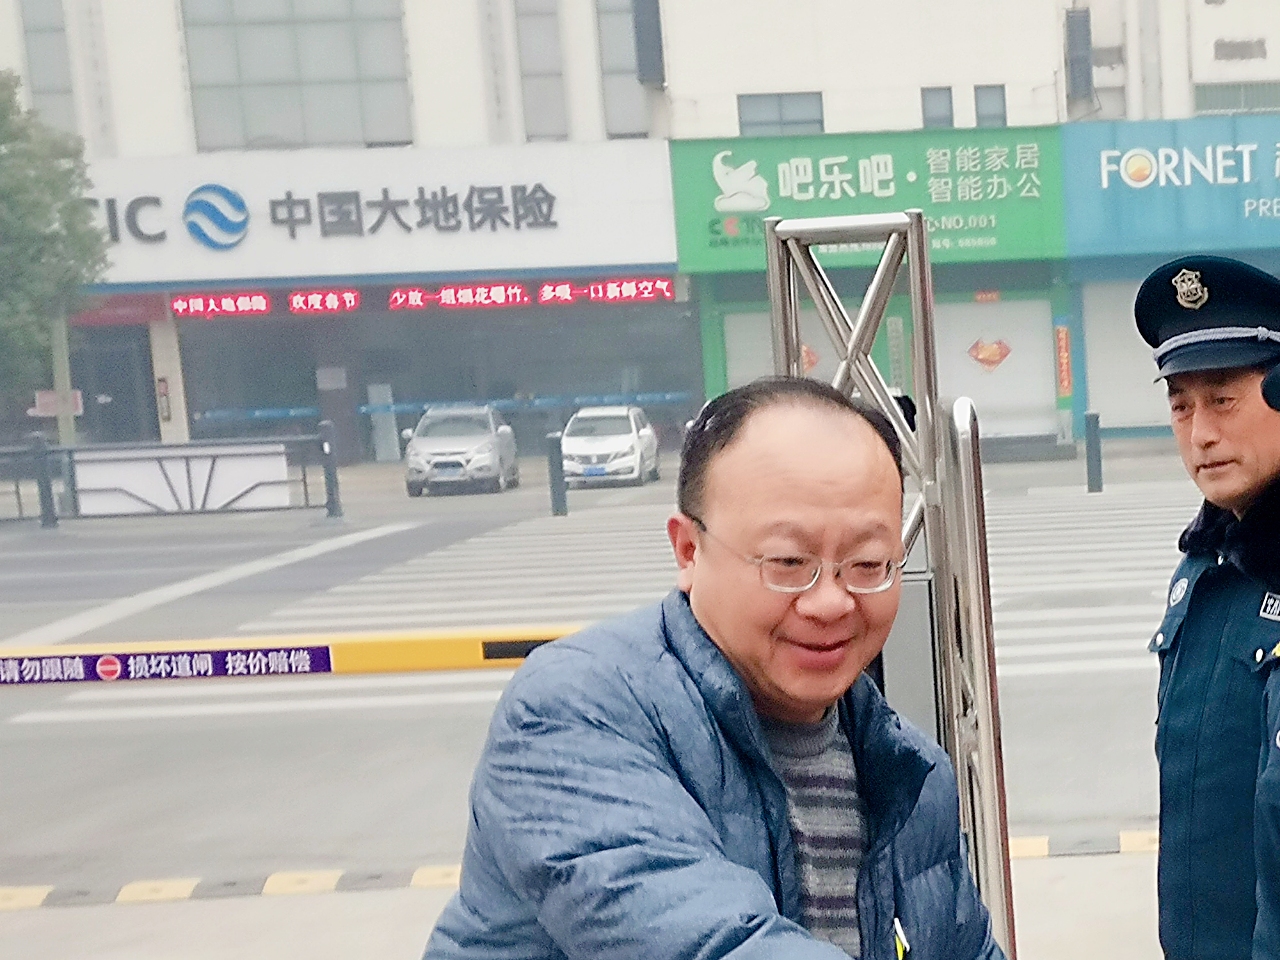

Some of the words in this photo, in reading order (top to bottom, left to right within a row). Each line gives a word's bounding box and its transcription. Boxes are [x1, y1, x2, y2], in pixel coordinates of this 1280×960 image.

[927, 143, 1041, 174] 智能家居
[1100, 144, 1258, 189] FORNET
[928, 172, 1042, 203] 智能办公
[269, 183, 558, 240] 中国大地保险
[127, 652, 213, 679] 损坏道闸
[225, 649, 311, 675] 按价赔偿
